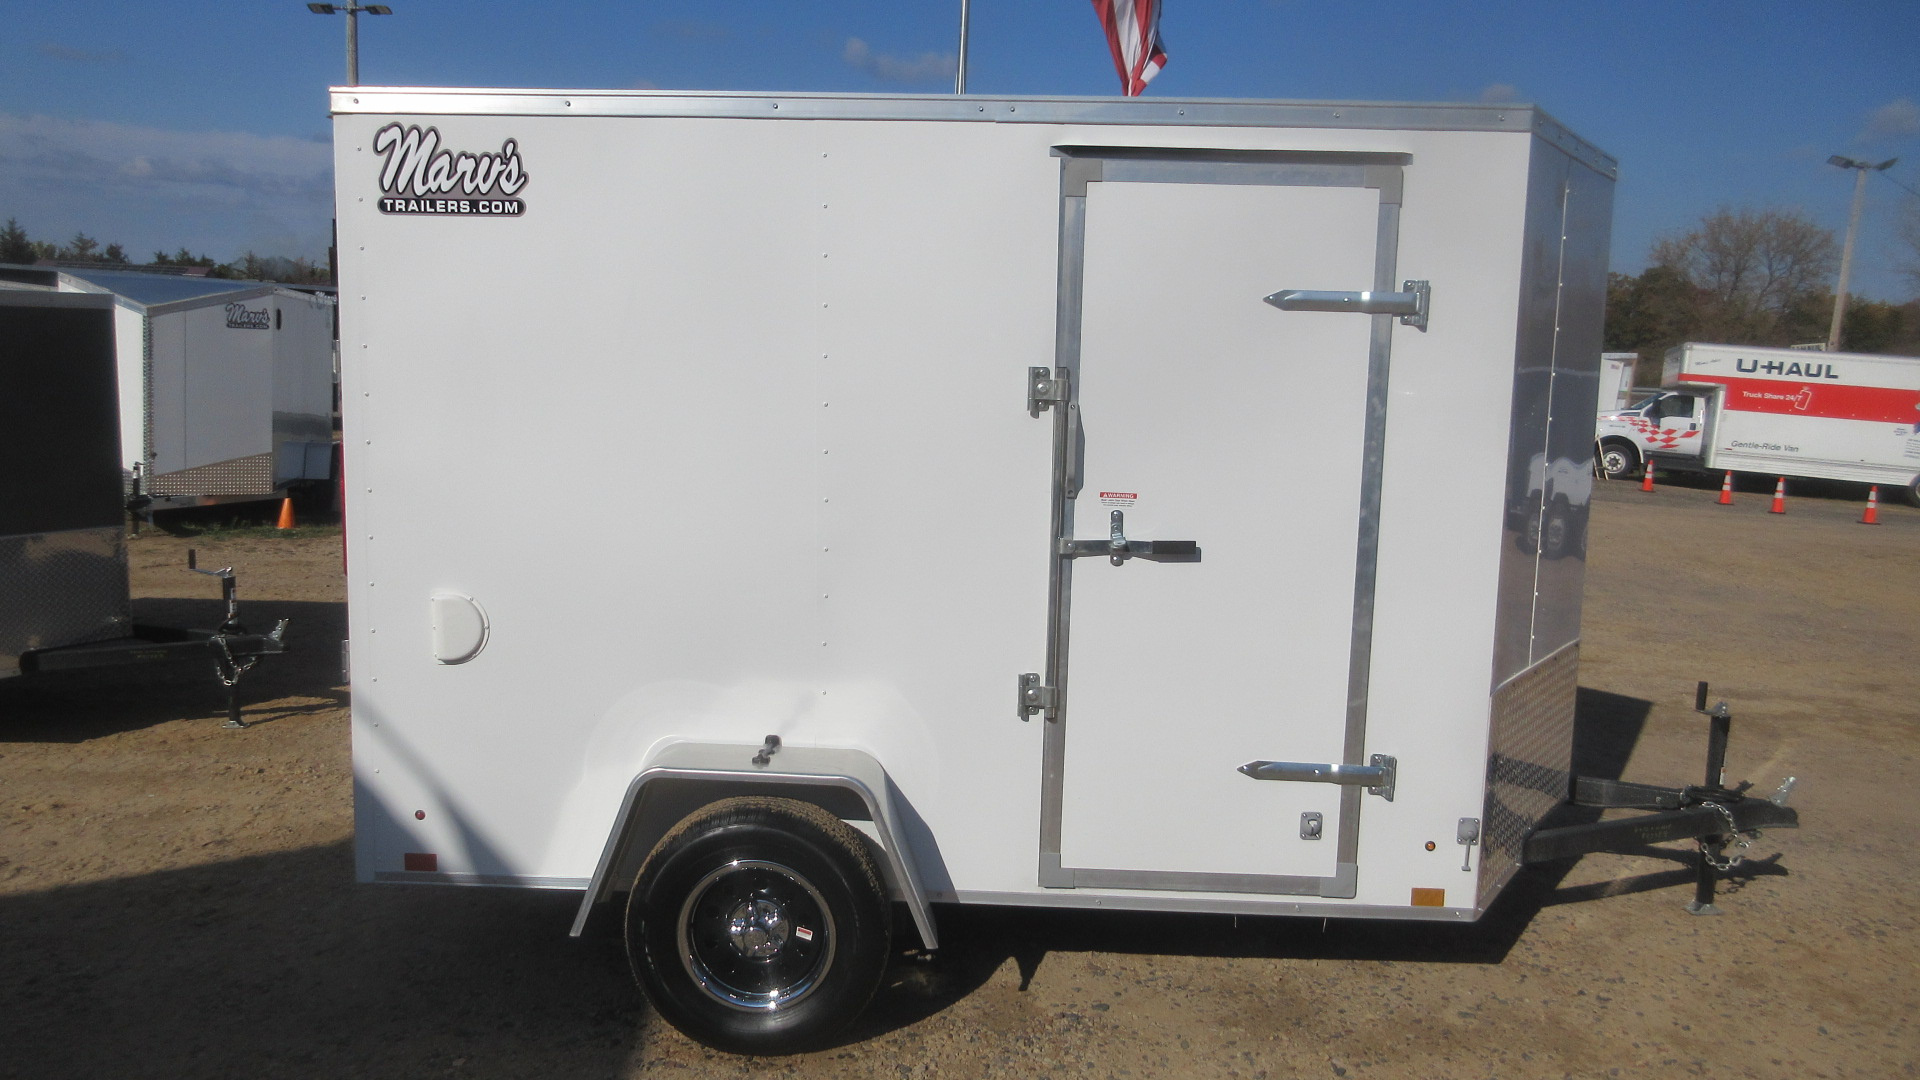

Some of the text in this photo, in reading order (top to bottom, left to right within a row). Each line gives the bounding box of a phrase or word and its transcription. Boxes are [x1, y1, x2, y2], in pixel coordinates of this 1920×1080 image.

[375, 123, 527, 197] Marv's
[383, 199, 519, 214] TRAILERS.COM
[225, 303, 270, 323] Marv's
[1742, 390, 1763, 398] Truck
[1763, 392, 1785, 401] Share
[1731, 440, 1799, 452] Gentle-Ride Van
